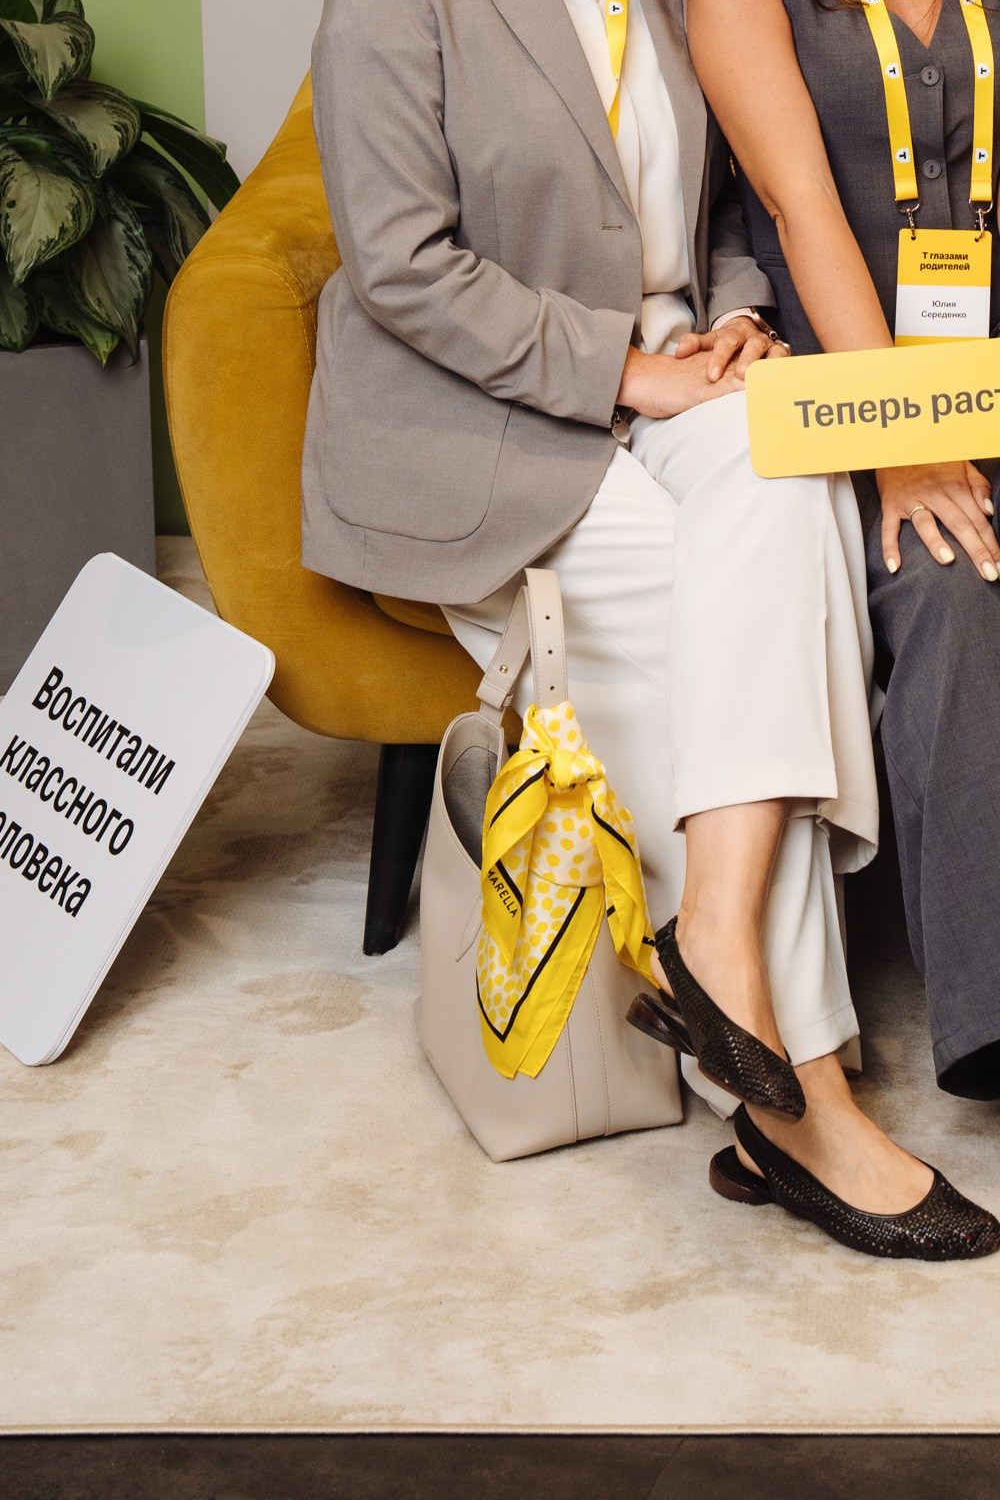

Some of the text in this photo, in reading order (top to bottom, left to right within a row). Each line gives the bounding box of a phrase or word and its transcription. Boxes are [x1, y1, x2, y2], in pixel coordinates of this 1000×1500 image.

[922, 251, 928, 259] Т
[919, 263, 970, 271] родителей
[932, 300, 957, 308] Юлия
[921, 310, 967, 319] Середенко
[794, 396, 922, 429] Теперь
[31, 666, 176, 795] Воспитали
[0, 734, 135, 856] классного
